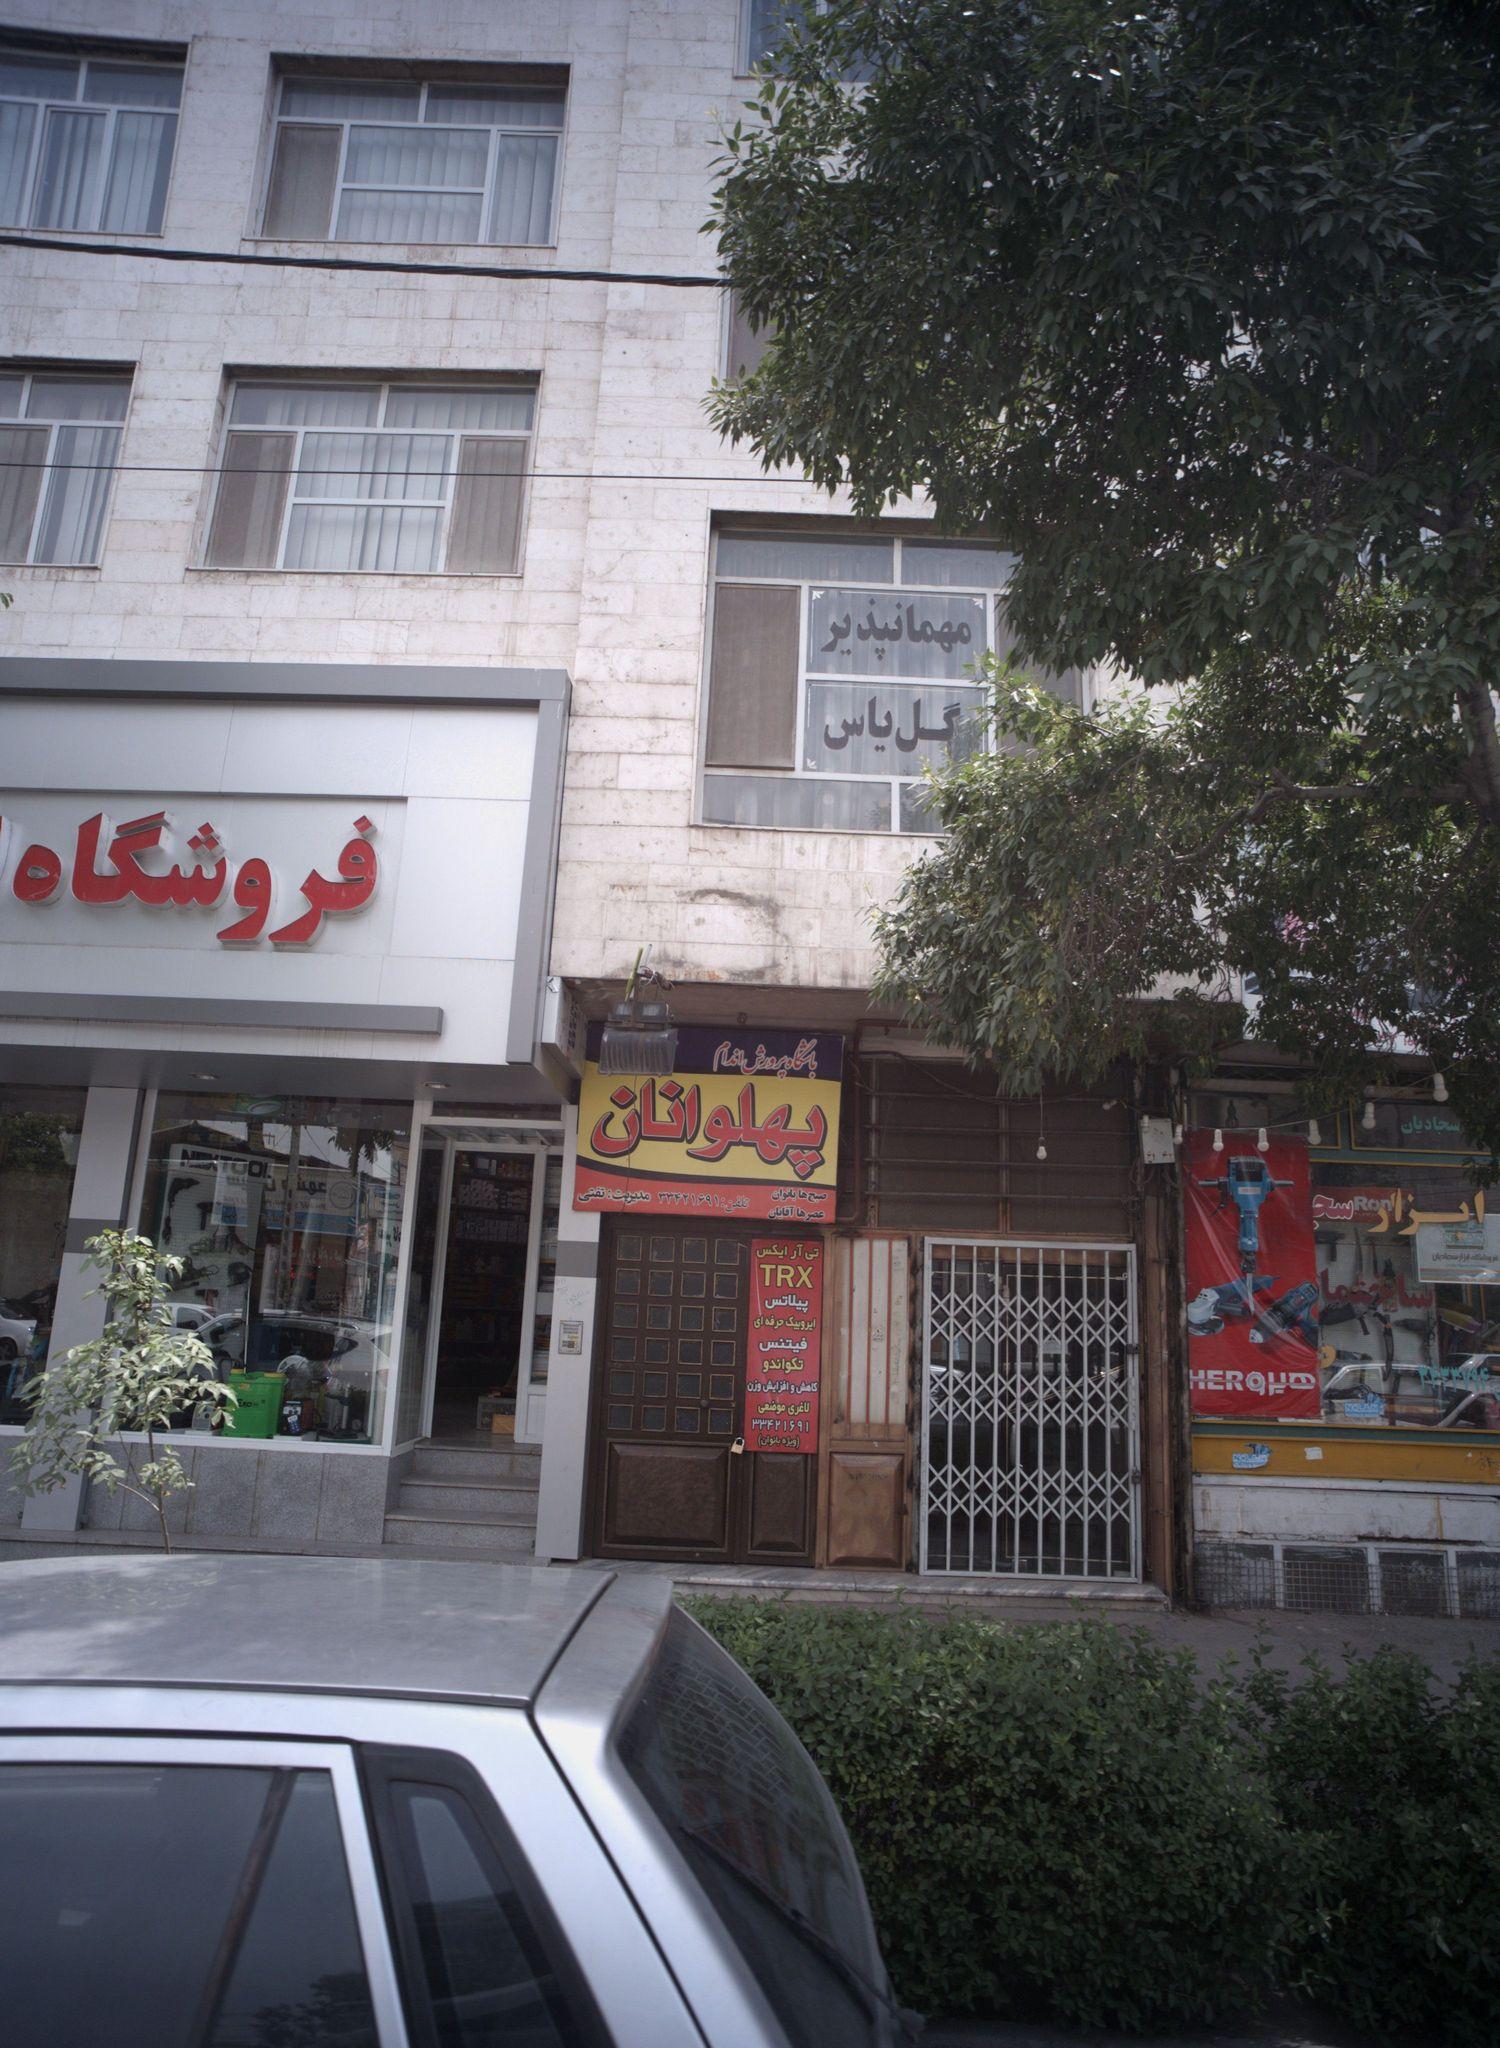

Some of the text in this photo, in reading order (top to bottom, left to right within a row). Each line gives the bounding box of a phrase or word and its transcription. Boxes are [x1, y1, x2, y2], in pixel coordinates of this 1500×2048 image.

[820, 597, 972, 661] مهمانپذیر
[823, 696, 962, 753] گل یاس
[12, 811, 382, 951] فروشگاه
[713, 1038, 818, 1079] باشگاه پرورش اندام
[591, 1077, 829, 1180] پهلوانان
[756, 1243, 788, 1258] ایکس
[760, 1264, 813, 1289] TRX
[764, 1294, 809, 1314] پیلاتس
[762, 1316, 785, 1331] حرفه
[758, 1337, 808, 1353] فیتنس
[762, 1356, 805, 1373] تکواندو
[747, 1381, 762, 1392] وزن
[763, 1380, 789, 1393] افزایش
[757, 1401, 810, 1415] لاغری موضعی
[751, 1418, 810, 1433] ۳۳۴۲۱۶۹۱
